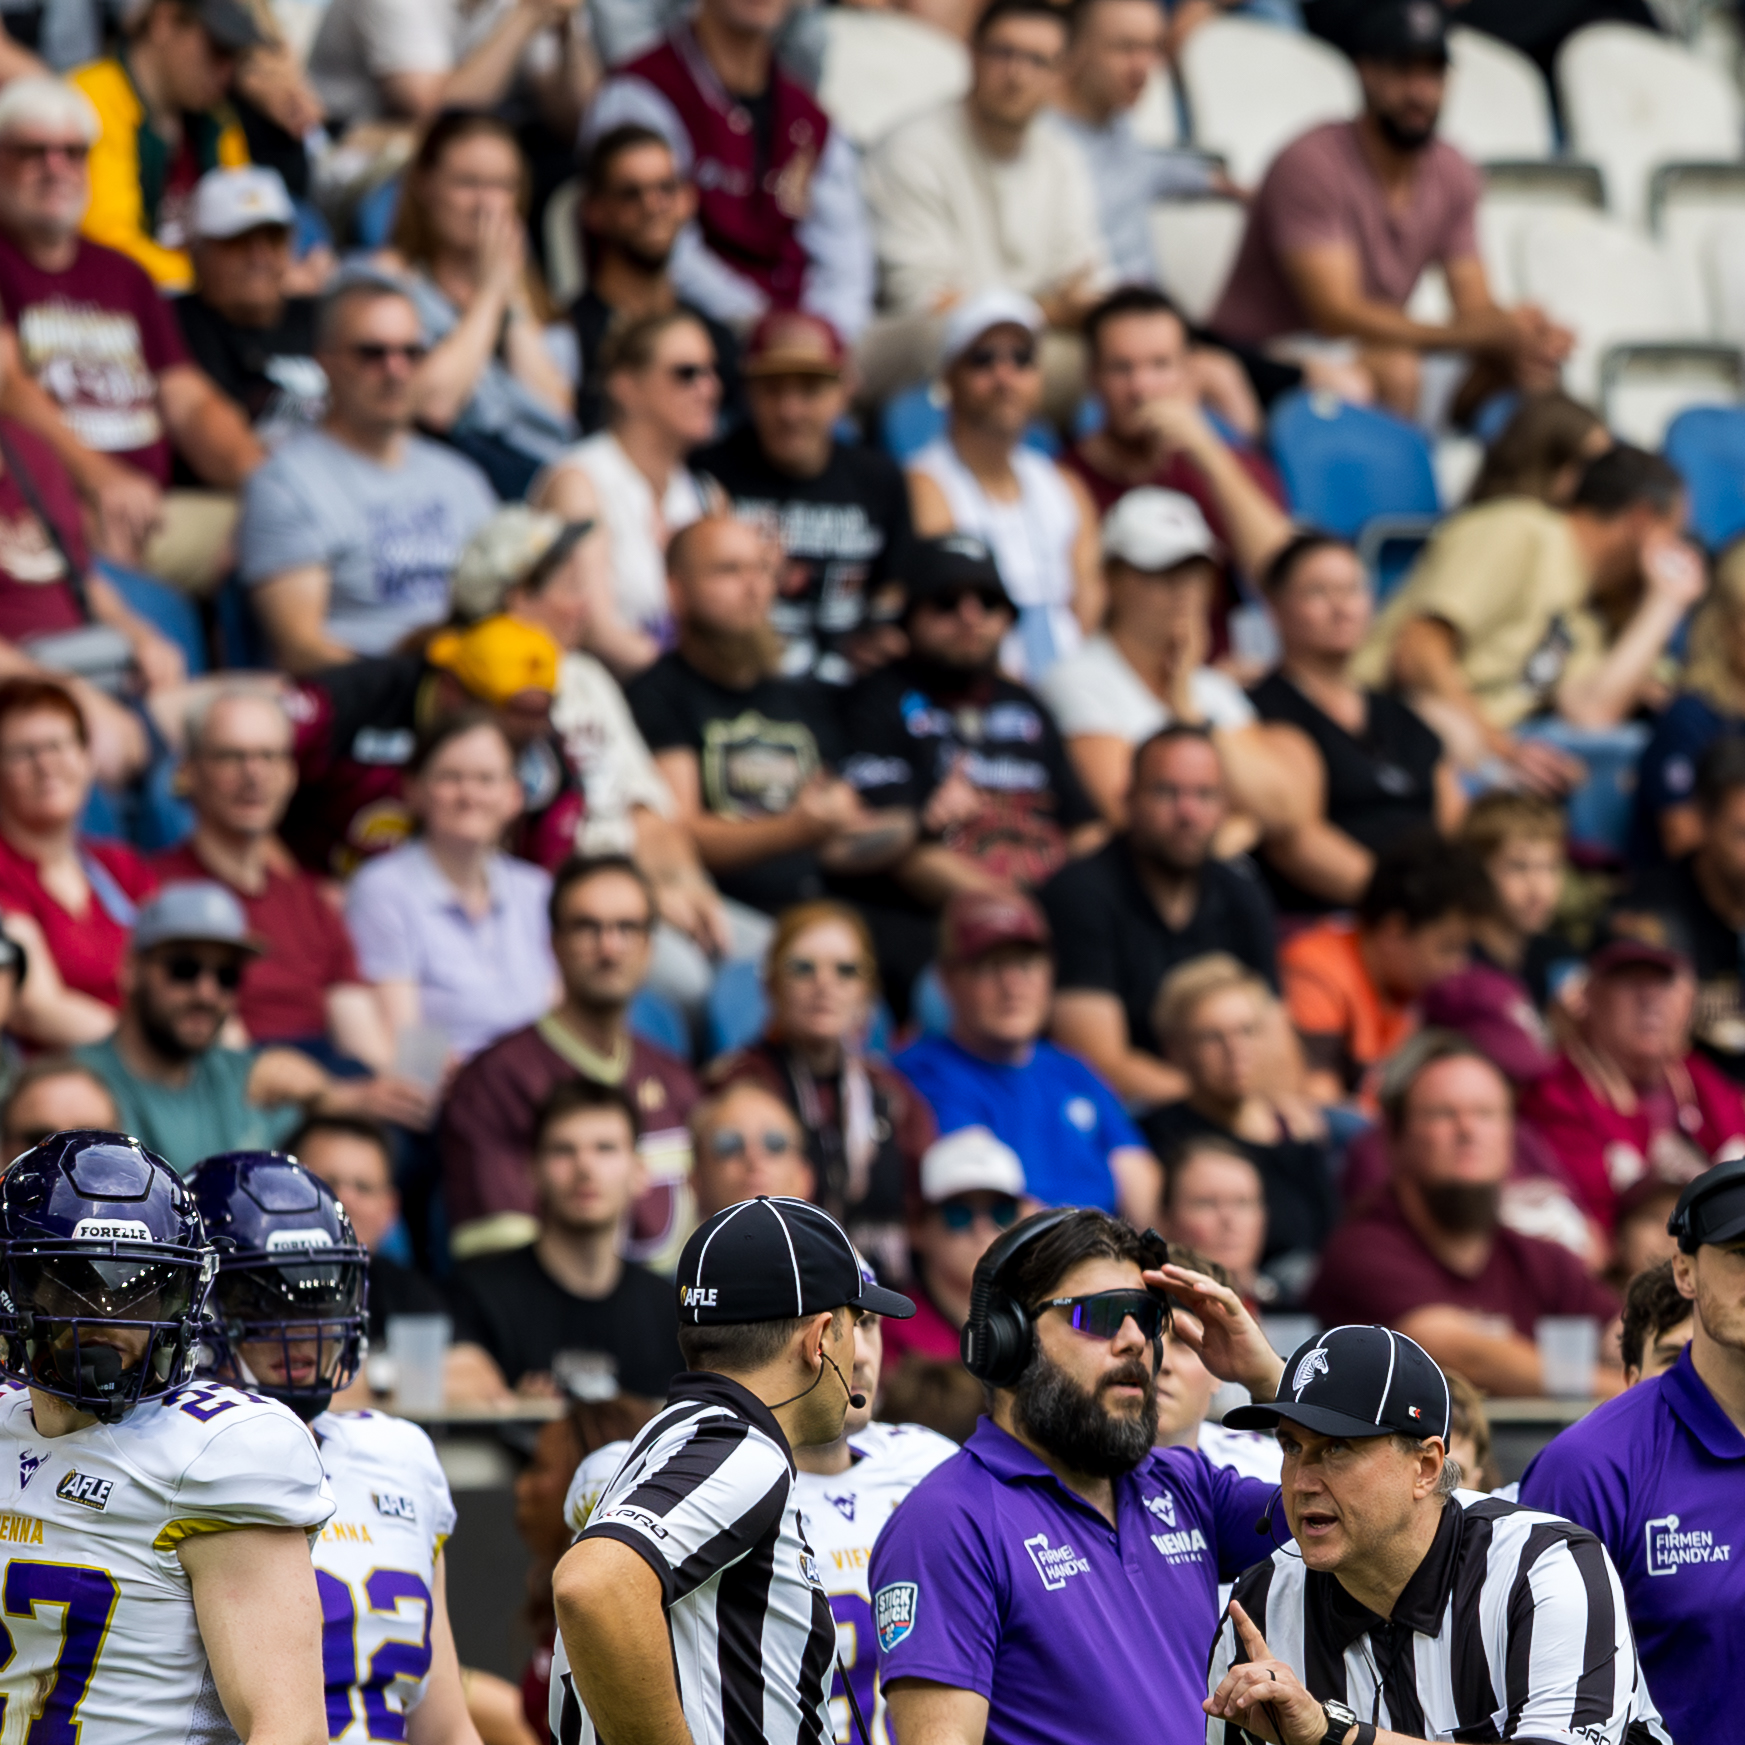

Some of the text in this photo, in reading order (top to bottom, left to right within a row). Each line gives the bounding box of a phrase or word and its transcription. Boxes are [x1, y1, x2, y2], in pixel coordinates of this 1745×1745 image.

[80, 1226, 147, 1241] FORELLE
[684, 1288, 718, 1306] AFLE
[62, 1472, 113, 1504] AFLE
[0, 1514, 44, 1545] ENNA
[600, 1509, 669, 1540] PRO
[1657, 1531, 1713, 1550] FIRMEN
[1657, 1545, 1731, 1566] HANDY.AT
[879, 1588, 911, 1612] STICK
